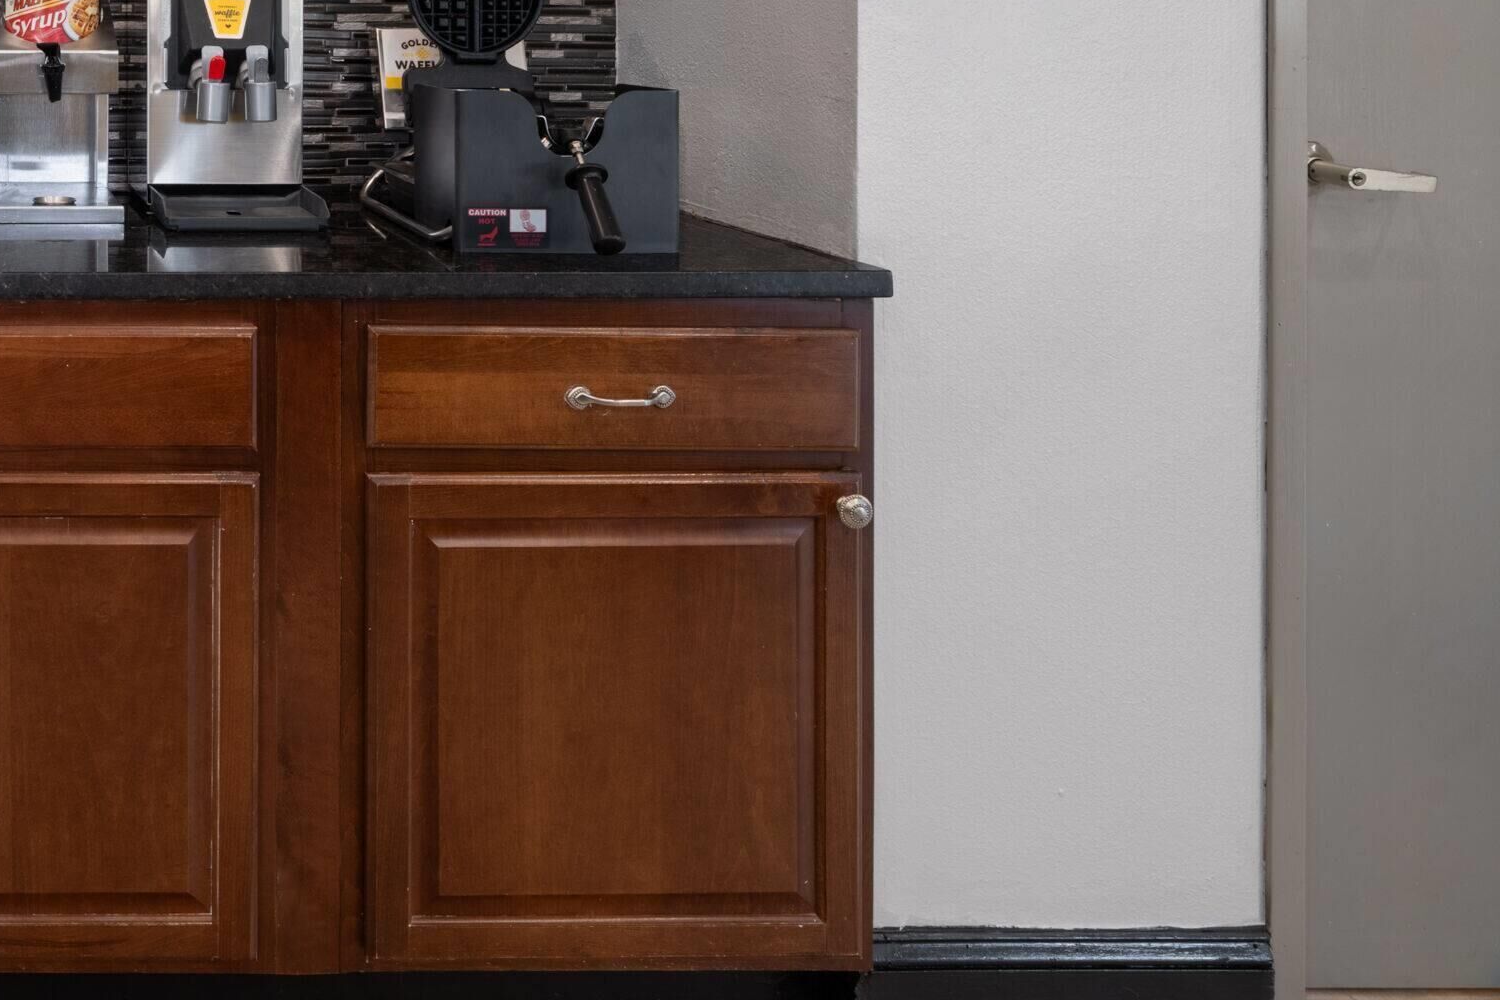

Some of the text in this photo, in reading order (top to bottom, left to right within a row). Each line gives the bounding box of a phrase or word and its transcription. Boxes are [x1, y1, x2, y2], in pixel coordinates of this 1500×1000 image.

[215, 10, 240, 19] waffle
[12, 10, 67, 37] Syrup
[401, 38, 438, 50] GOLDE
[395, 60, 437, 70] WAFFL
